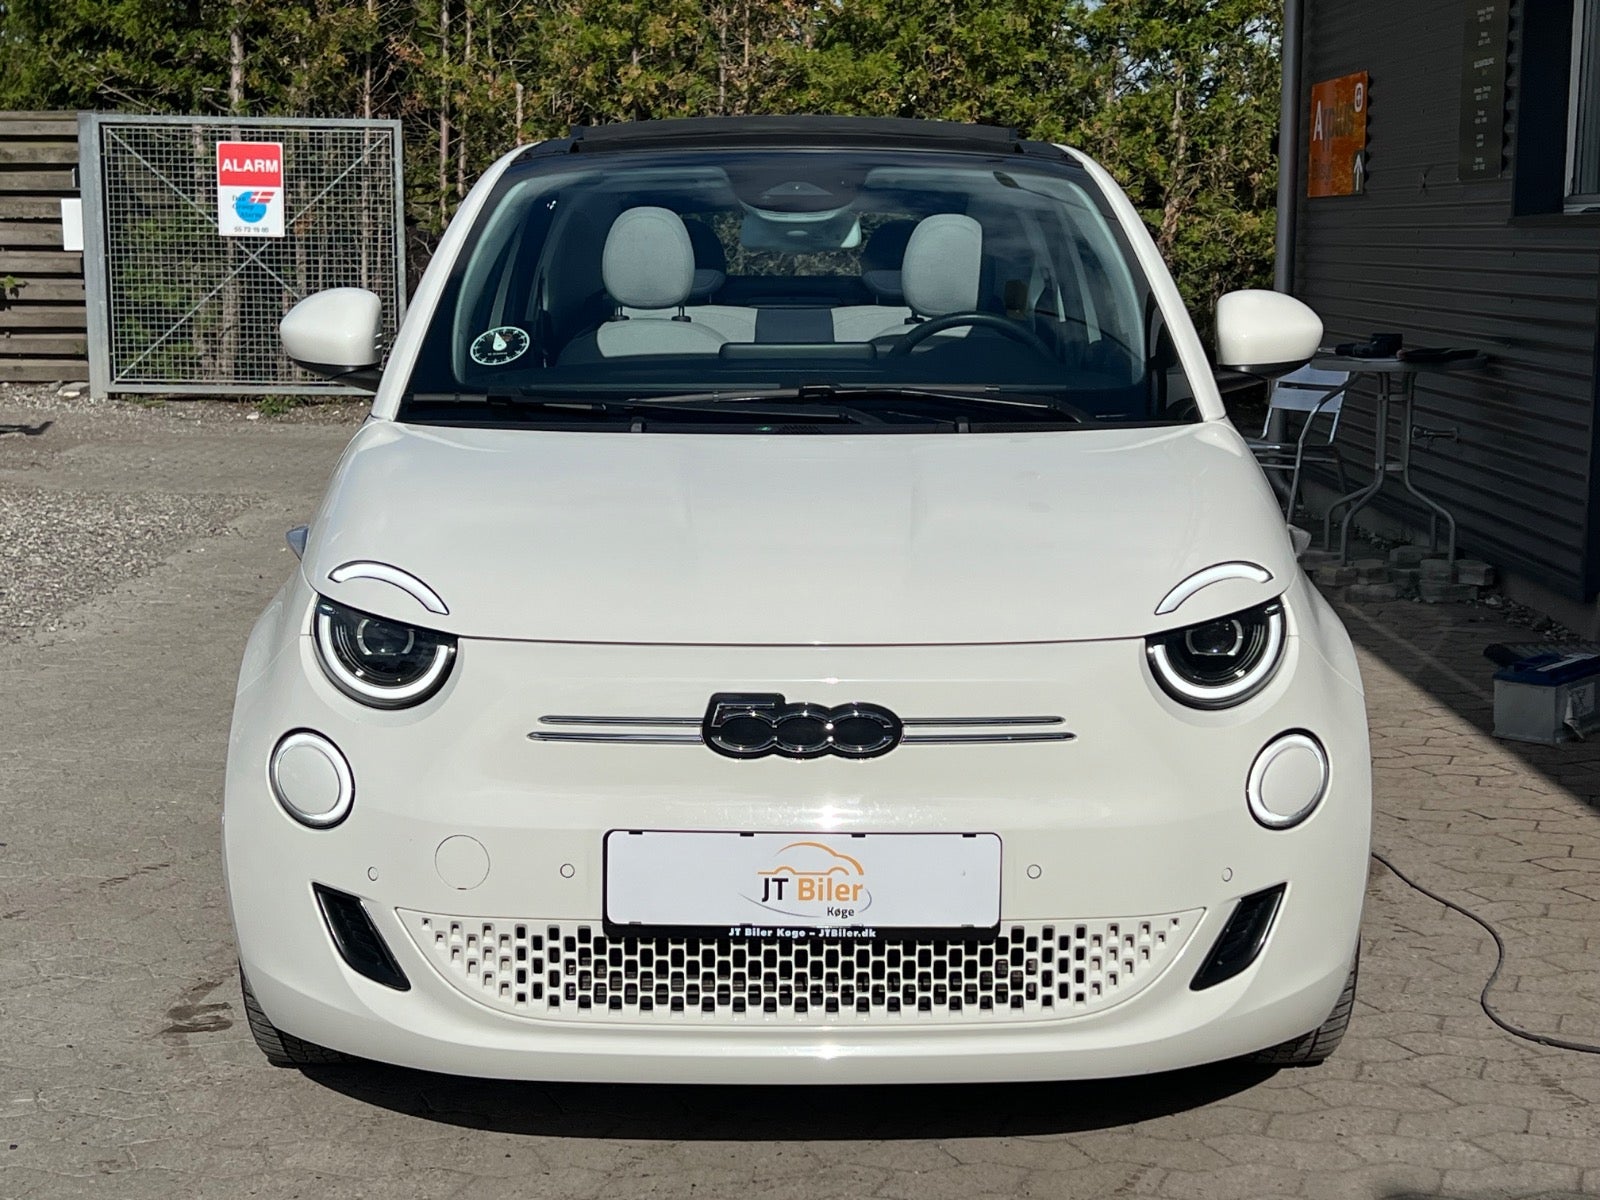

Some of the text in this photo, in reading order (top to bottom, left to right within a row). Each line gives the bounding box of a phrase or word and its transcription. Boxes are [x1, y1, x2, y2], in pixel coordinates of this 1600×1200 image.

[221, 159, 279, 172] ALARM
[703, 693, 903, 760] 500
[762, 878, 863, 902] JT Biler
[827, 906, 854, 919] Køge
[729, 927, 741, 936] JT
[745, 928, 773, 937] Biler
[819, 928, 876, 938] JTBiler.dk
